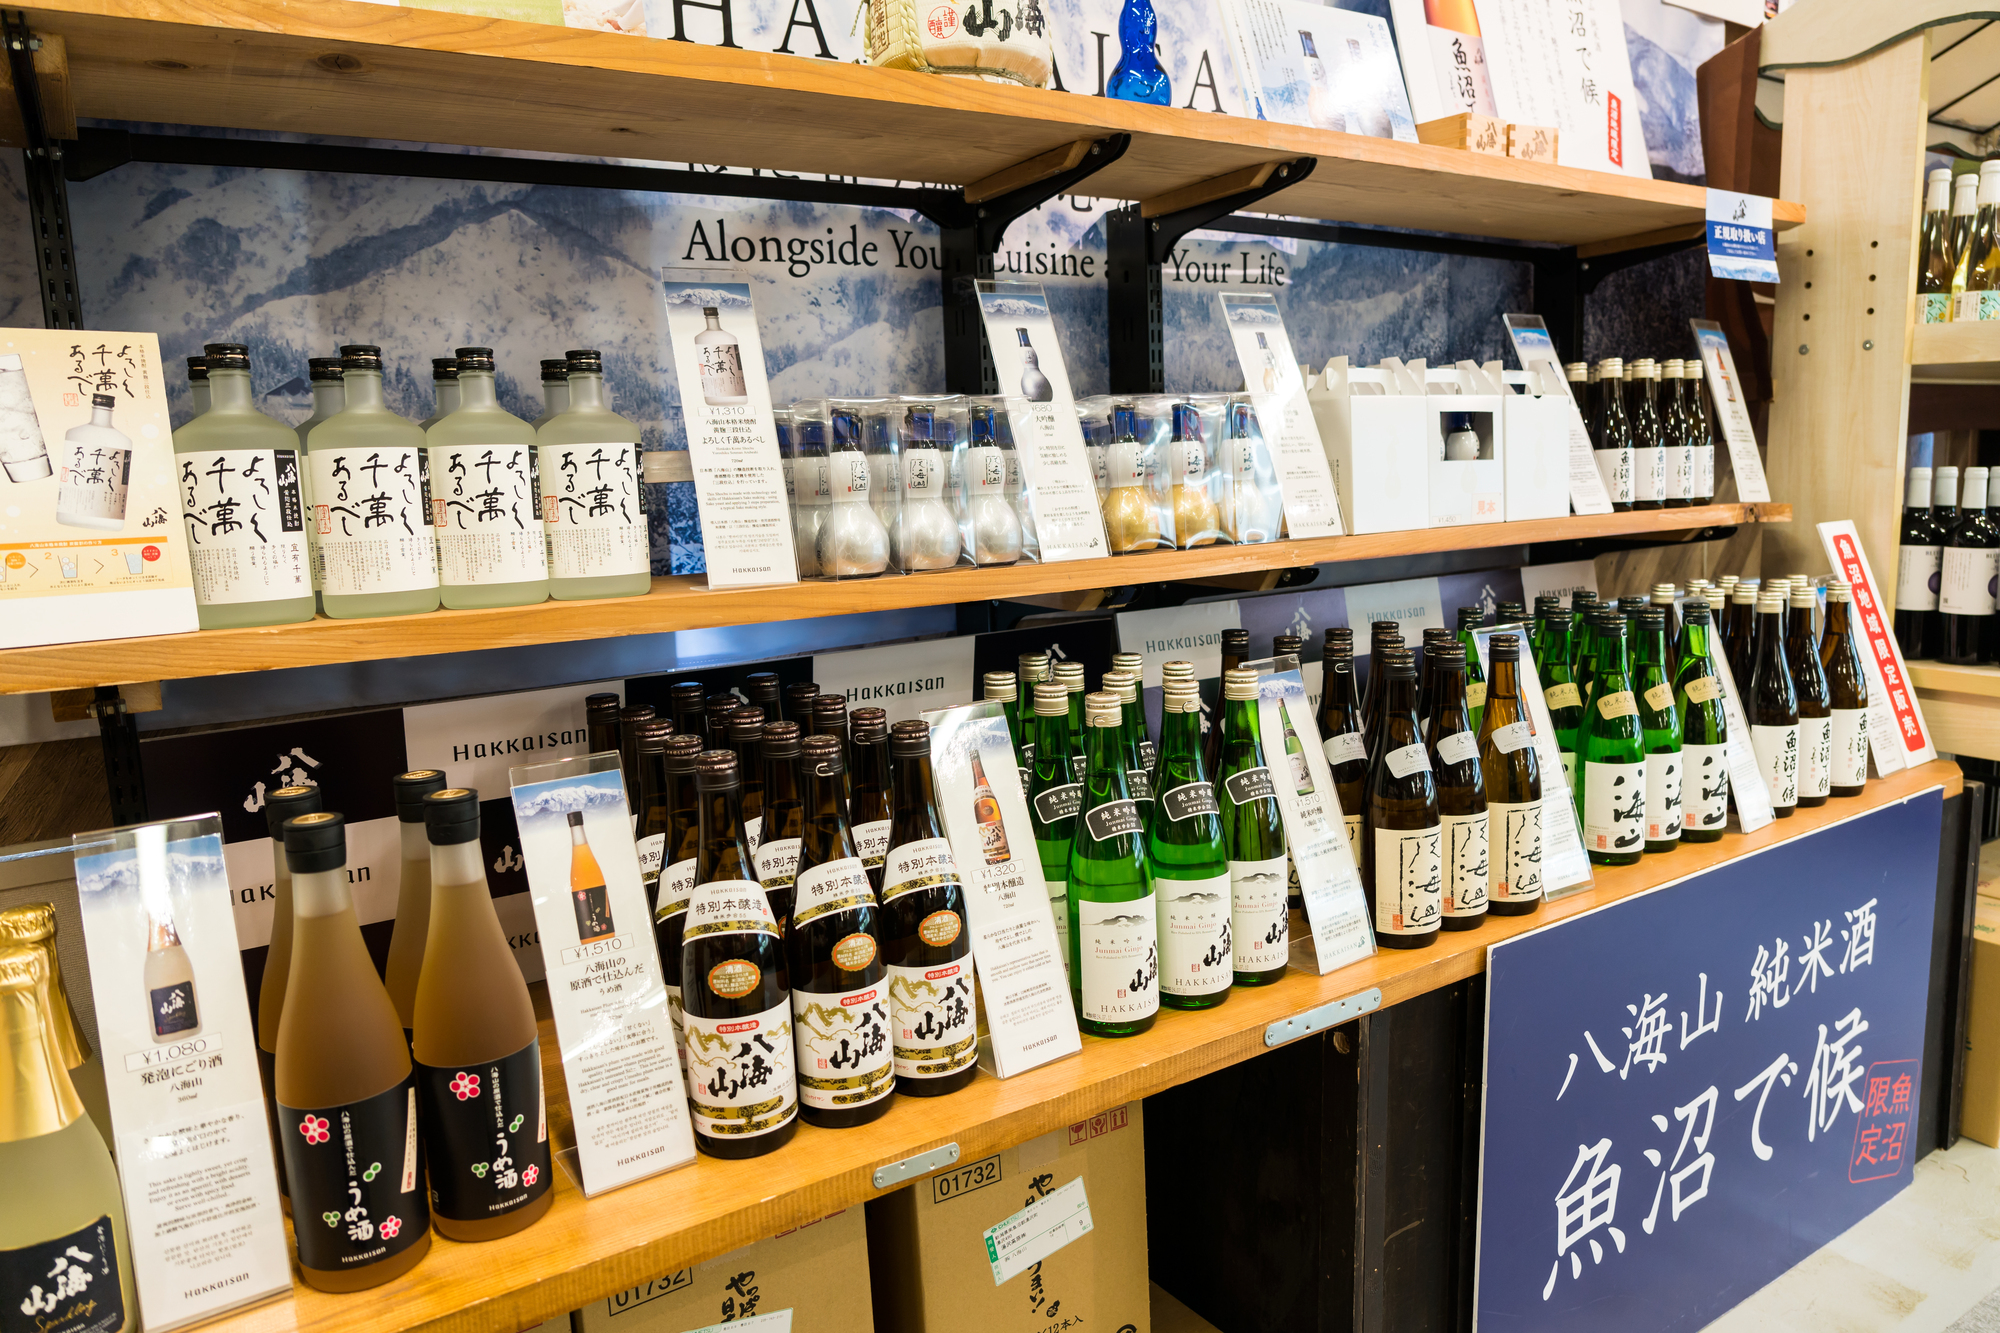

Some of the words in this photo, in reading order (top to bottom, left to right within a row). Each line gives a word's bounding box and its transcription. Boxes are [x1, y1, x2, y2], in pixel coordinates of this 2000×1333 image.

[1566, 0, 1601, 107] 沼で候
[681, 218, 879, 278] Alongside
[887, 228, 946, 271] You
[1170, 246, 1231, 285] Your
[1240, 250, 1286, 288] Life
[67, 345, 93, 396] あるべし
[92, 344, 118, 391] 千萬
[117, 345, 136, 398] よろしく
[702, 435, 766, 445] よろしく千萬あるべし
[182, 461, 208, 544] あるべし
[206, 456, 243, 536] 千萬
[242, 456, 270, 543] よろしく
[330, 456, 361, 536] あるべし
[360, 453, 394, 528] 千萬
[394, 453, 416, 536] よろしく
[446, 453, 475, 530] あるべし
[474, 450, 506, 522] 千萬
[506, 450, 526, 529] よろしく
[558, 451, 586, 524] あるべし
[586, 448, 615, 517] 千萬
[615, 448, 633, 524] よろしく
[1476, 500, 1496, 515] 見本
[45, 552, 52, 560] 2
[111, 549, 119, 557] 3
[1367, 606, 1425, 624] Hakkaisan
[1838, 538, 1918, 738] 魚沼地域限定販売
[1146, 632, 1221, 654] Hakkaisan
[847, 676, 945, 703] Hakkaisan
[453, 727, 588, 763] Hakkaisan
[761, 855, 799, 872] 特別本
[854, 836, 889, 852] 特別本
[696, 898, 763, 916] 特別本醸造
[1170, 922, 1196, 930] Junmai
[585, 957, 627, 975] 八海山の
[1095, 946, 1122, 954] Junmai
[570, 963, 645, 992] 原酒で仕込んだ
[599, 983, 623, 997] うめ酒
[1556, 972, 1724, 1101] 八海山
[1745, 898, 1877, 1023] 純米酒
[914, 977, 970, 1041] 八海山
[829, 1002, 887, 1070] 八海山
[141, 1054, 223, 1086] 発泡にごり酒
[169, 1077, 203, 1093] 八海山
[707, 1033, 775, 1100] 八海山
[1855, 1076, 1888, 1166] 限定
[1879, 1073, 1912, 1162] 魚沼
[492, 1132, 518, 1190] うめ酒
[617, 1145, 665, 1167] Hakkaisan
[938, 1161, 996, 1193] 01732
[1542, 1007, 1869, 1301] 魚沼で候
[345, 1180, 374, 1241] うめ酒
[488, 1193, 528, 1211] Hakkaisan
[341, 1246, 387, 1263] Hakkaisan
[184, 1272, 249, 1299] Hakkaisan
